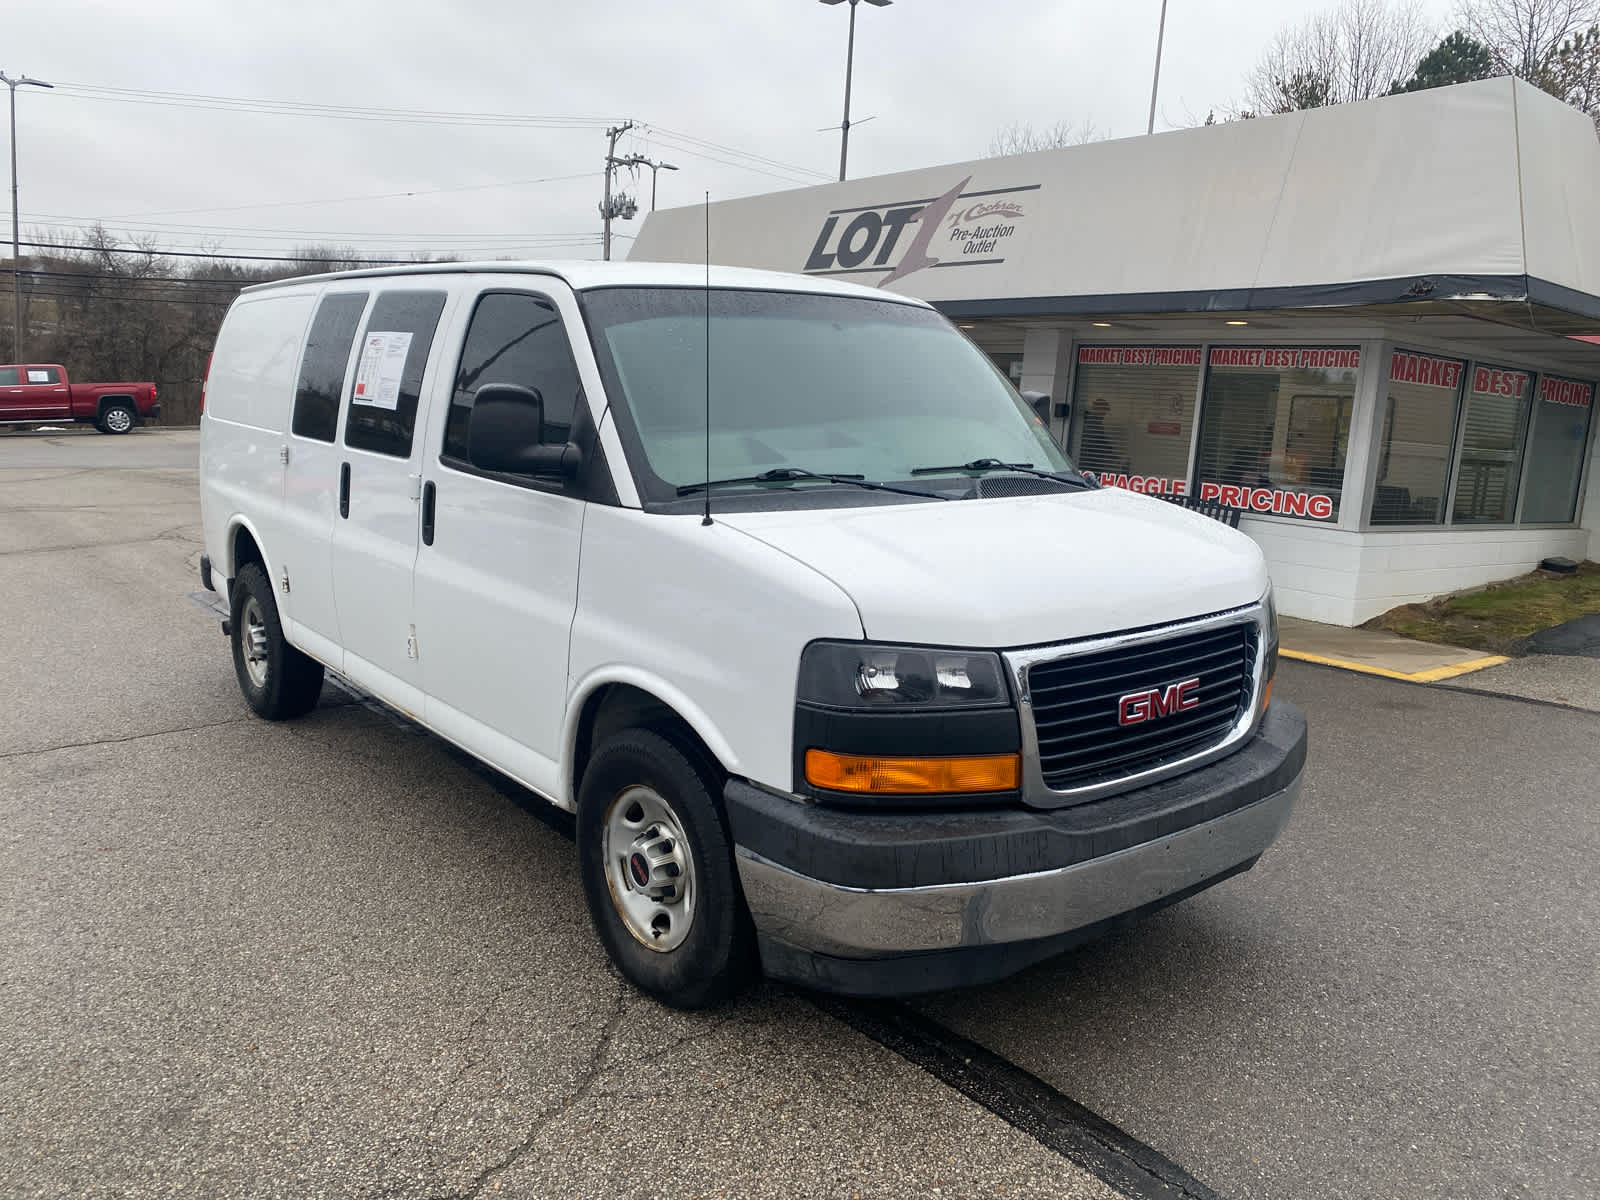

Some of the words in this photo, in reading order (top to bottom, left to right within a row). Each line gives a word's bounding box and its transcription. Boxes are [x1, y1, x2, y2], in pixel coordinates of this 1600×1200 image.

[803, 207, 924, 270] LOT
[950, 223, 1015, 242] Pre-Auction
[963, 239, 997, 255] Outlet
[1079, 347, 1122, 365] MARKET
[1122, 348, 1152, 365] BEST
[1152, 348, 1202, 366] PRICING
[1210, 348, 1262, 368] MARKET
[1263, 349, 1298, 368] BEST
[1299, 349, 1361, 369] PRICING
[1389, 352, 1463, 390] MARKET
[1474, 366, 1528, 399] BEST
[1538, 376, 1592, 408] PRICING
[1200, 481, 1333, 519] PRICING
[1119, 678, 1200, 726] GMC
